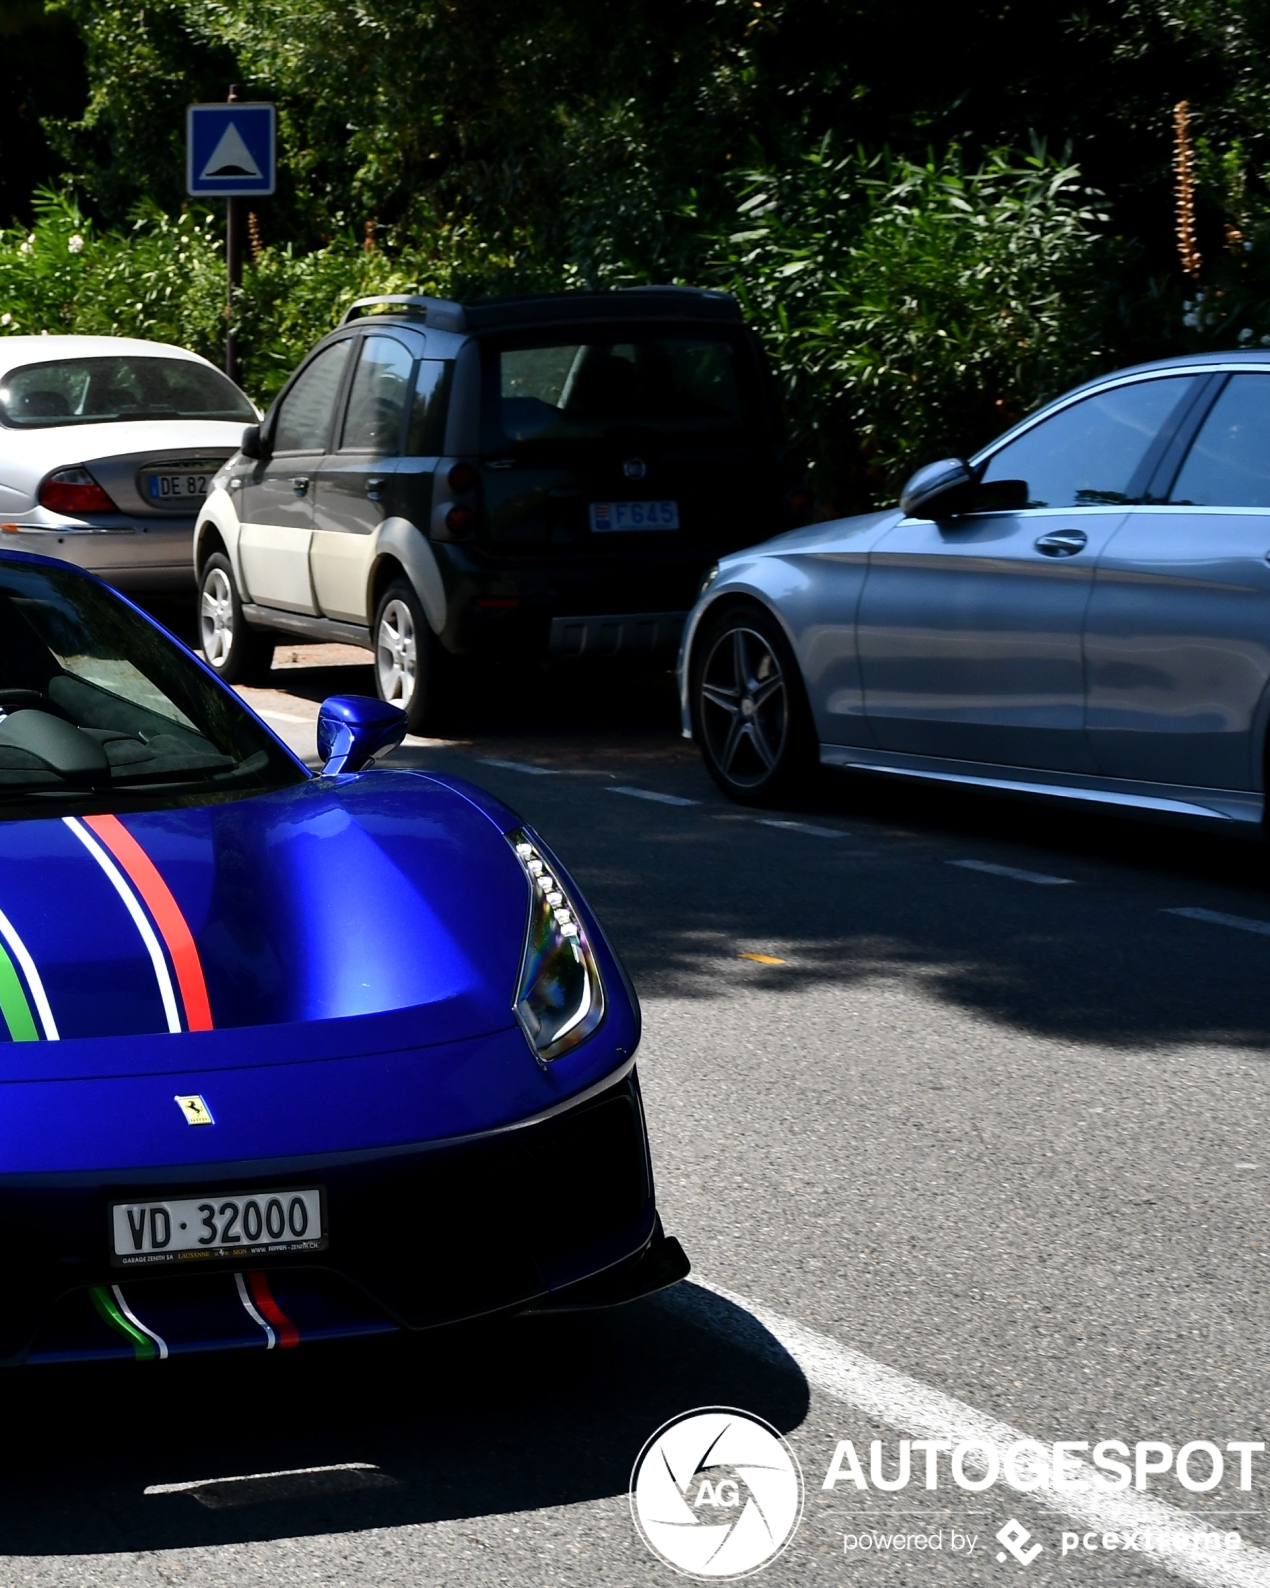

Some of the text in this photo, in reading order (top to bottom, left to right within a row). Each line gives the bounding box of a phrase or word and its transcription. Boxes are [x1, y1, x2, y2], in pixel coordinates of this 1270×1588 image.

[160, 476, 207, 495] DE 82
[615, 502, 674, 525] F645
[197, 1197, 308, 1245] 32000
[122, 1255, 147, 1264] GARAGE
[147, 1254, 165, 1262] ZENITH
[177, 1251, 210, 1259] LAUSANNE
[232, 1248, 247, 1256] SION
